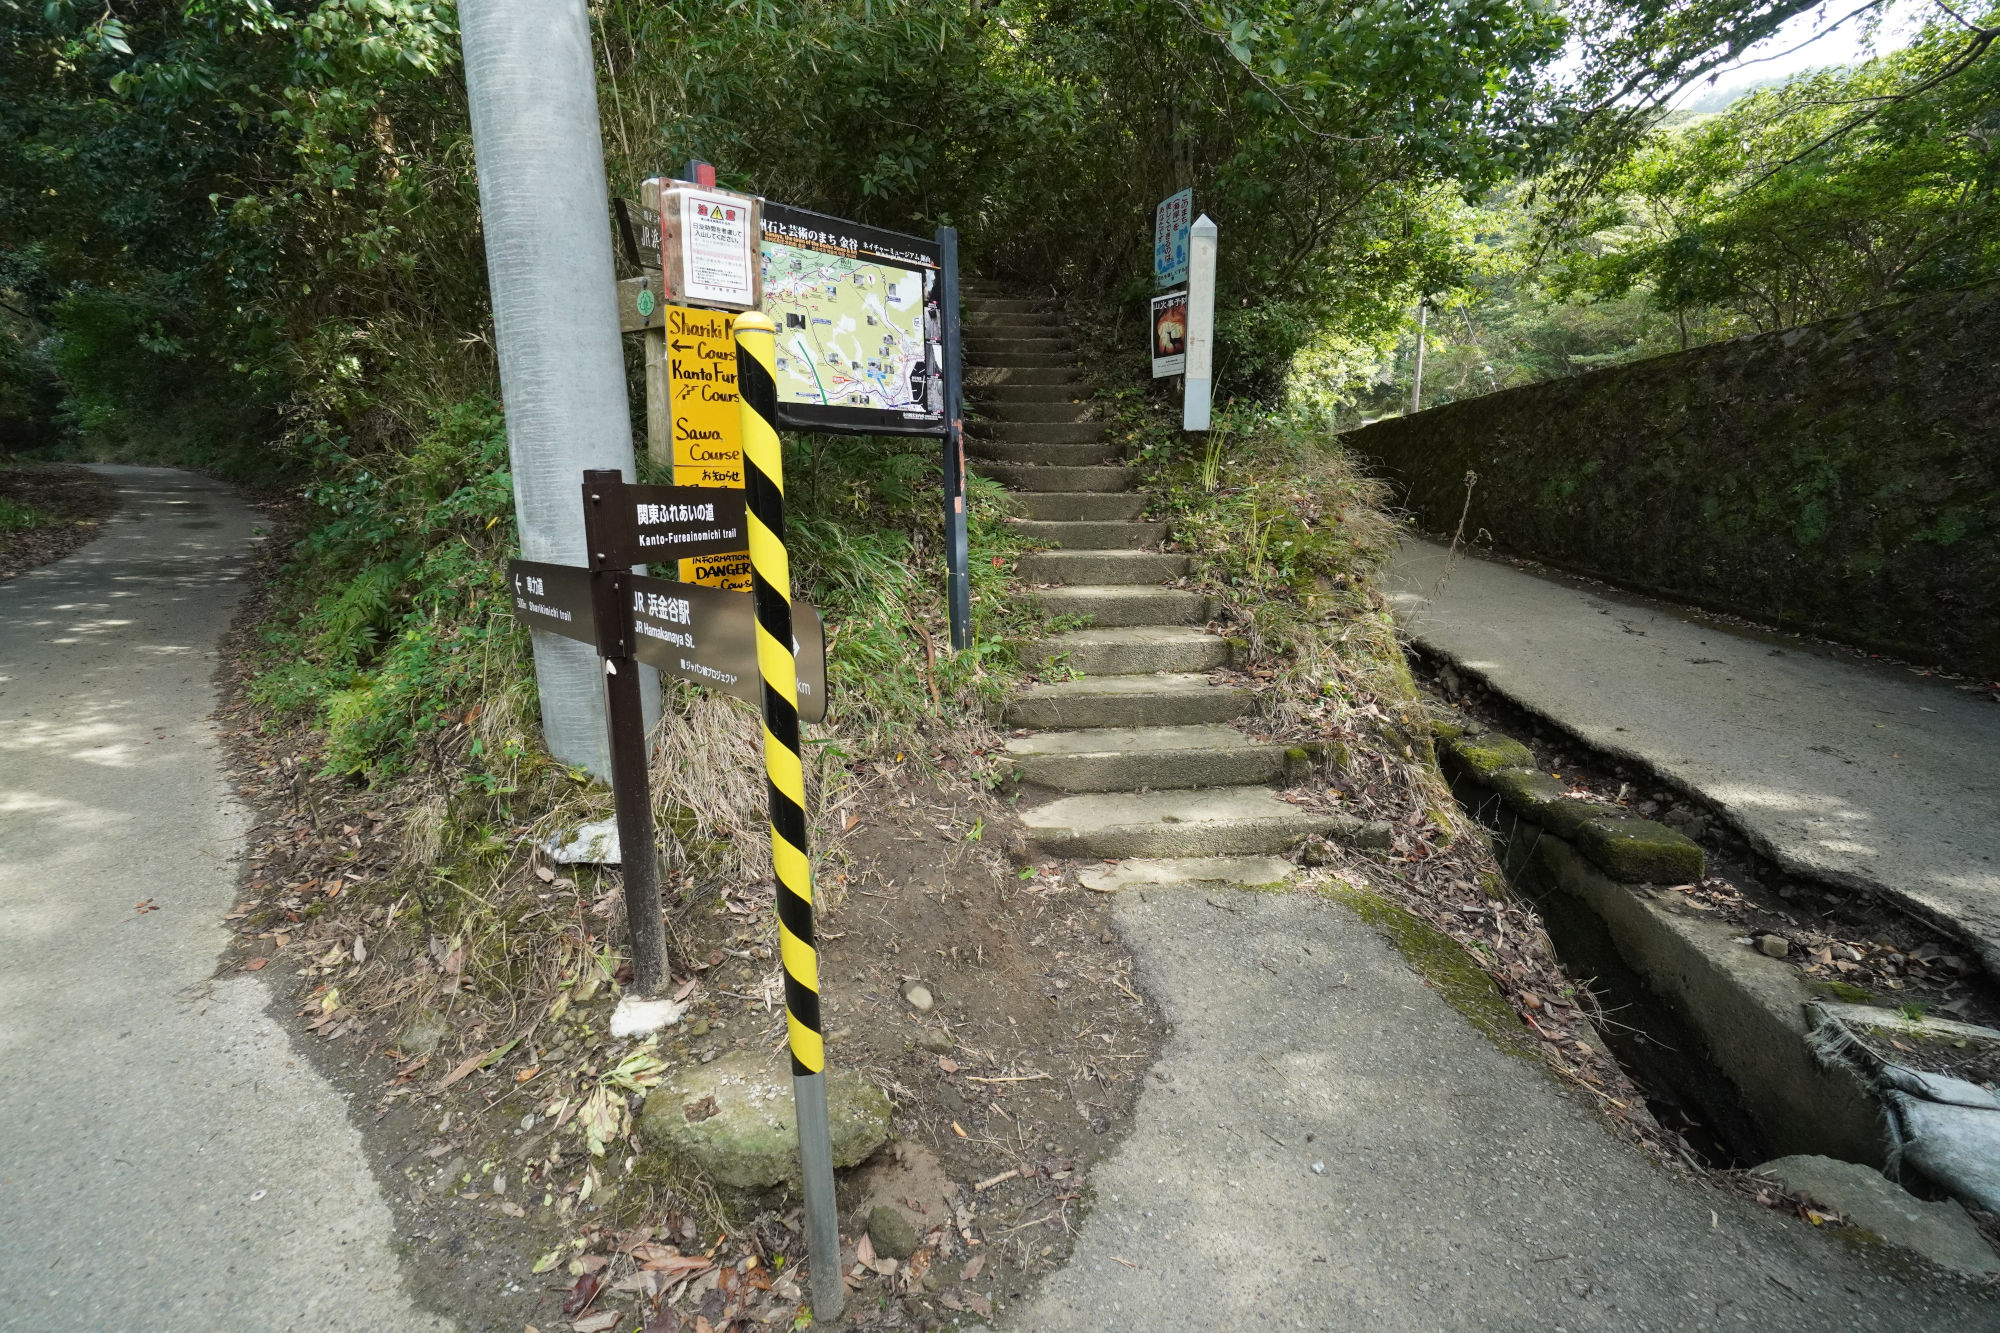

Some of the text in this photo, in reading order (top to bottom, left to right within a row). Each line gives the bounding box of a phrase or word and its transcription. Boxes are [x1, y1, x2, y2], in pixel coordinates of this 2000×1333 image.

[697, 203, 736, 221] 注 意
[694, 230, 739, 244] 入山してください。
[840, 236, 858, 250] 金谷
[670, 311, 722, 338] Shariki
[698, 341, 736, 361] Cours
[672, 359, 712, 381] Kanto
[702, 384, 740, 402] Cours
[676, 417, 722, 440] Sawa
[690, 444, 740, 460] Course
[702, 469, 741, 482] お知らせ
[636, 503, 714, 526] 関東ふれあいの道
[638, 528, 736, 546] Kanto-Fureainomichi trail
[692, 554, 750, 564] INFORMATION
[526, 576, 544, 596] 車力道
[560, 610, 572, 622] trail
[633, 591, 691, 626] JR 浜金谷駅
[635, 620, 696, 648] JR Hamakanaya St.
[796, 677, 811, 695] km
